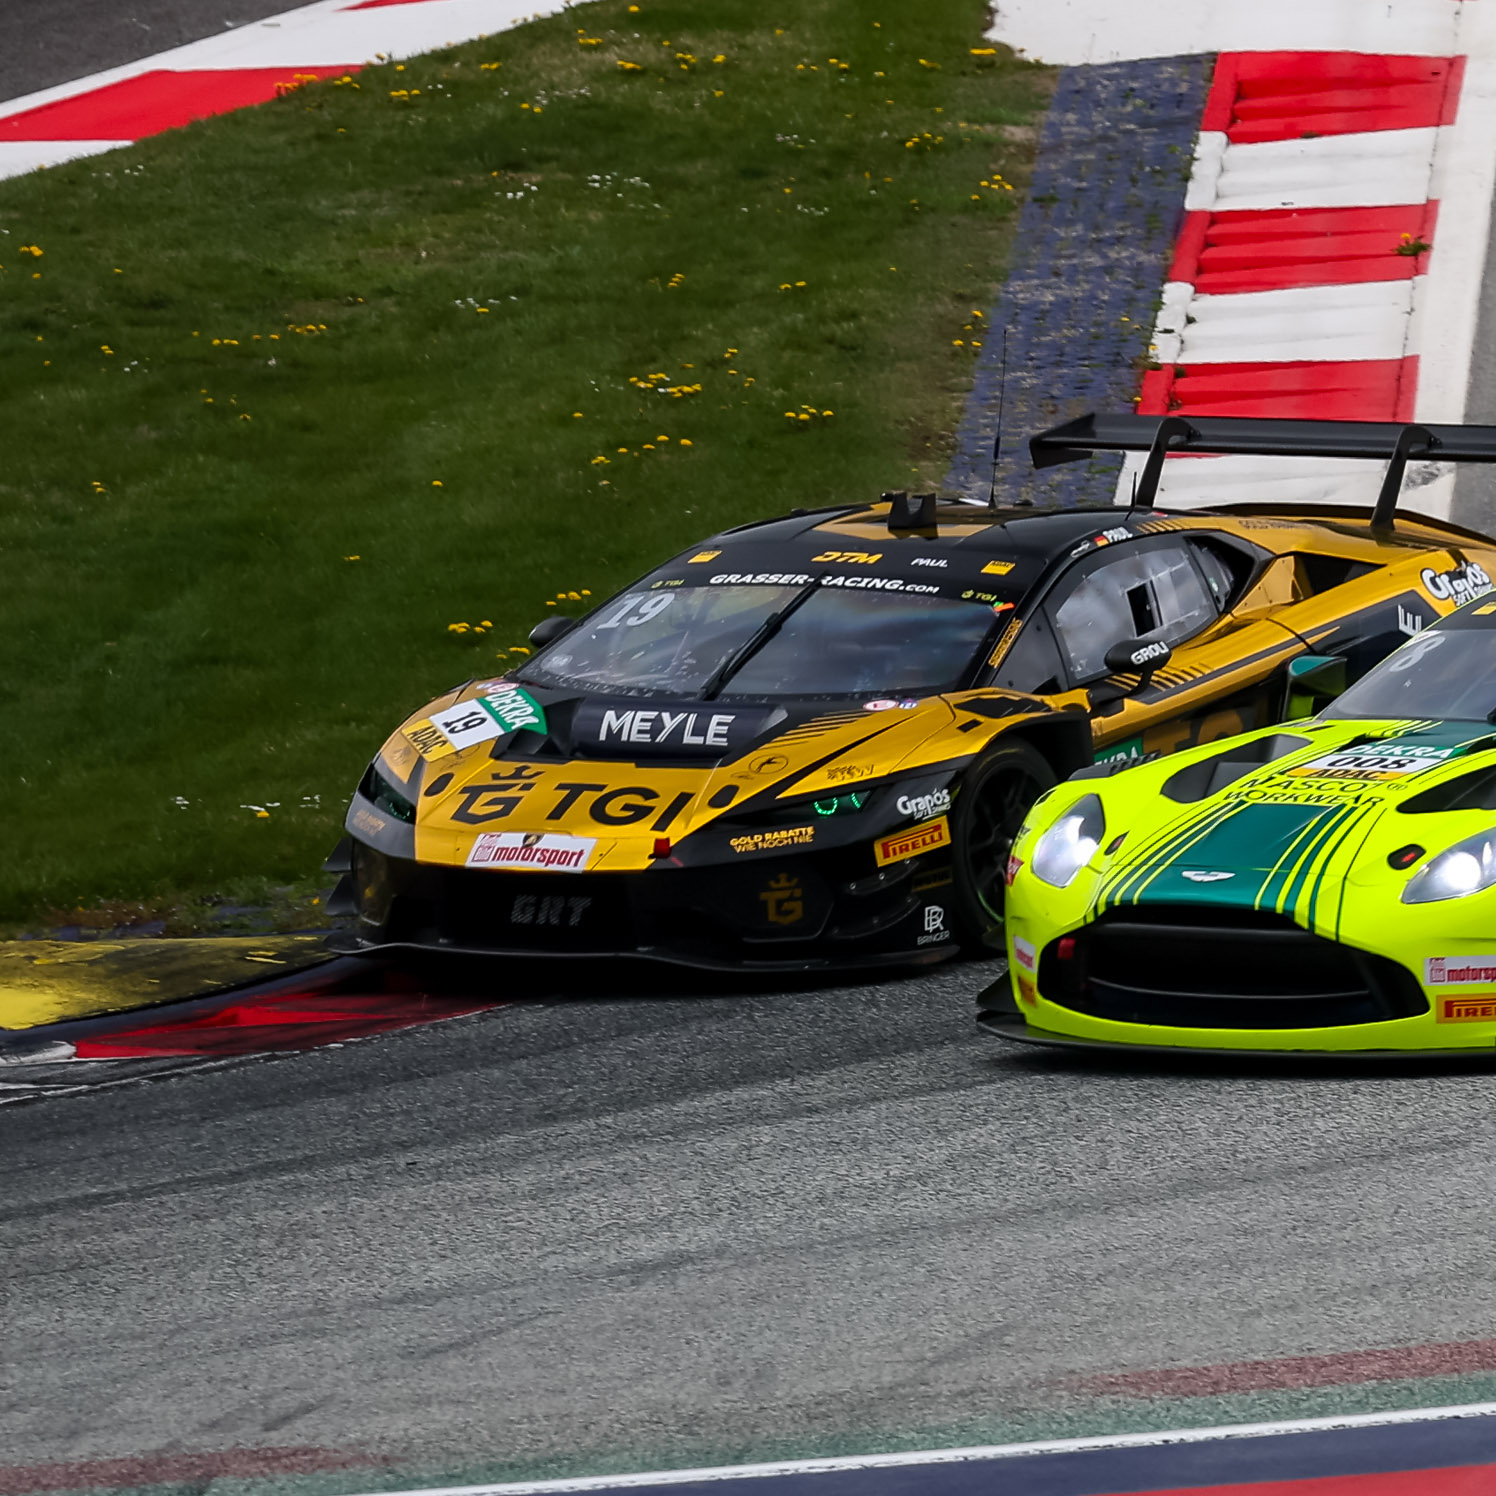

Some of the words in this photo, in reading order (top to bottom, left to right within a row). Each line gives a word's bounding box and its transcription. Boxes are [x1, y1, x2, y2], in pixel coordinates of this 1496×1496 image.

[1103, 526, 1132, 543] PAUL
[811, 551, 883, 564] DTM
[911, 557, 949, 568] PAUL
[597, 592, 676, 632] 19
[487, 689, 540, 730] DEKRA
[442, 709, 488, 735] 19
[599, 709, 736, 746] MEYLE
[407, 726, 448, 755] ADAC
[1346, 743, 1455, 760] DEKRA
[1336, 756, 1418, 770] 008
[1309, 769, 1389, 780] ADAC
[544, 782, 697, 832] TGI
[897, 788, 951, 816] Grapós
[1221, 789, 1386, 806] WORKWEAR
[730, 834, 761, 847] GOLD
[764, 826, 815, 842] RABATTE
[734, 842, 753, 853] WIE
[756, 838, 787, 851] NOCH
[788, 834, 813, 846] NIE
[882, 824, 943, 860] PIRELLI
[492, 846, 585, 867] motorsport
[510, 895, 592, 926] GRT
[917, 930, 950, 945] BRINGER
